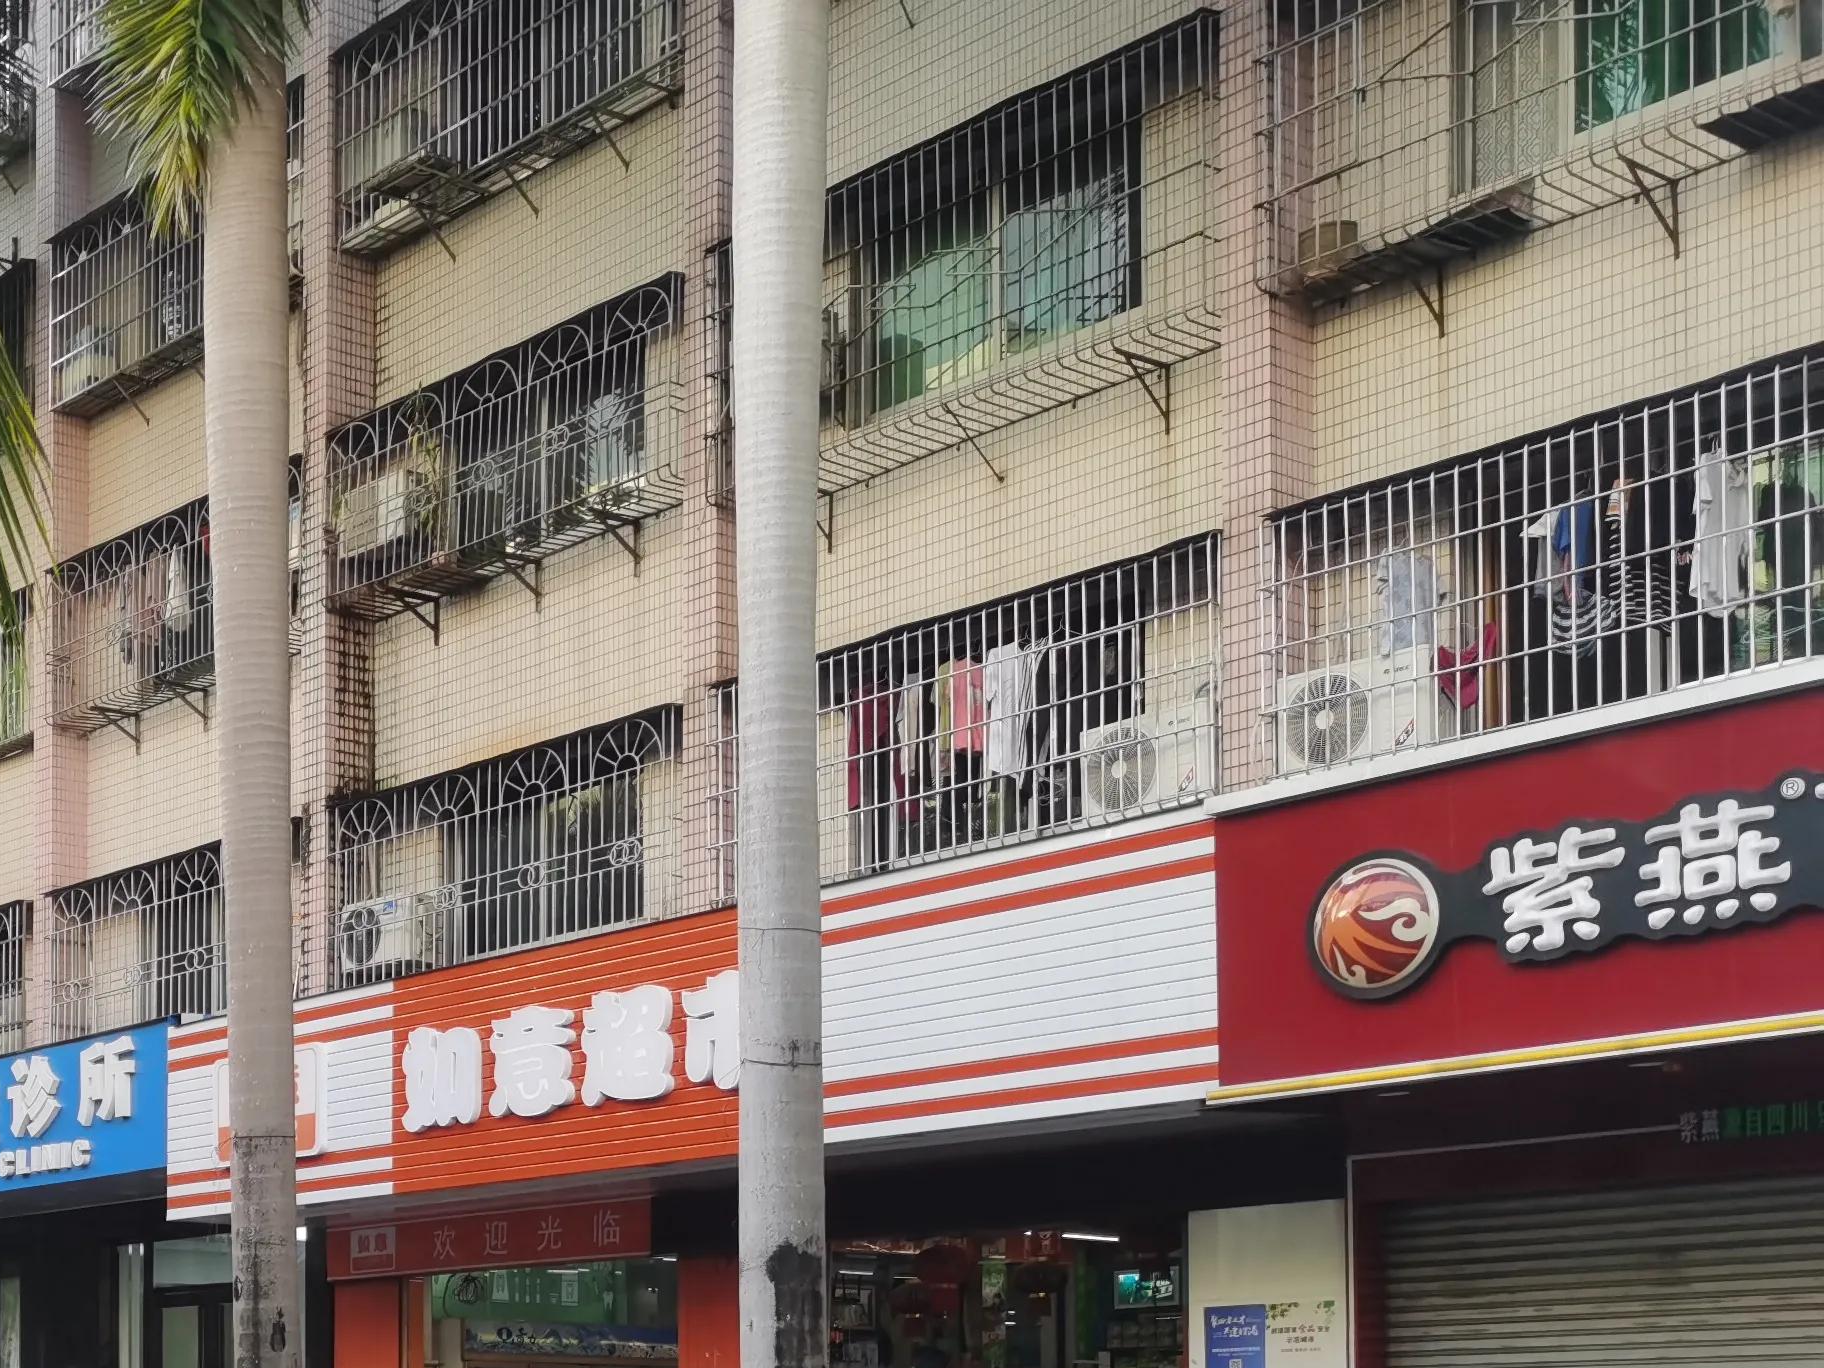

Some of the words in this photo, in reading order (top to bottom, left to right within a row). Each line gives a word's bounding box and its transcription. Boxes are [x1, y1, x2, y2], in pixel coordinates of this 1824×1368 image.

[1482, 799, 1791, 953] 紫燕
[401, 969, 740, 1134] 如意超市
[432, 1208, 621, 1260] 欢迎光临
